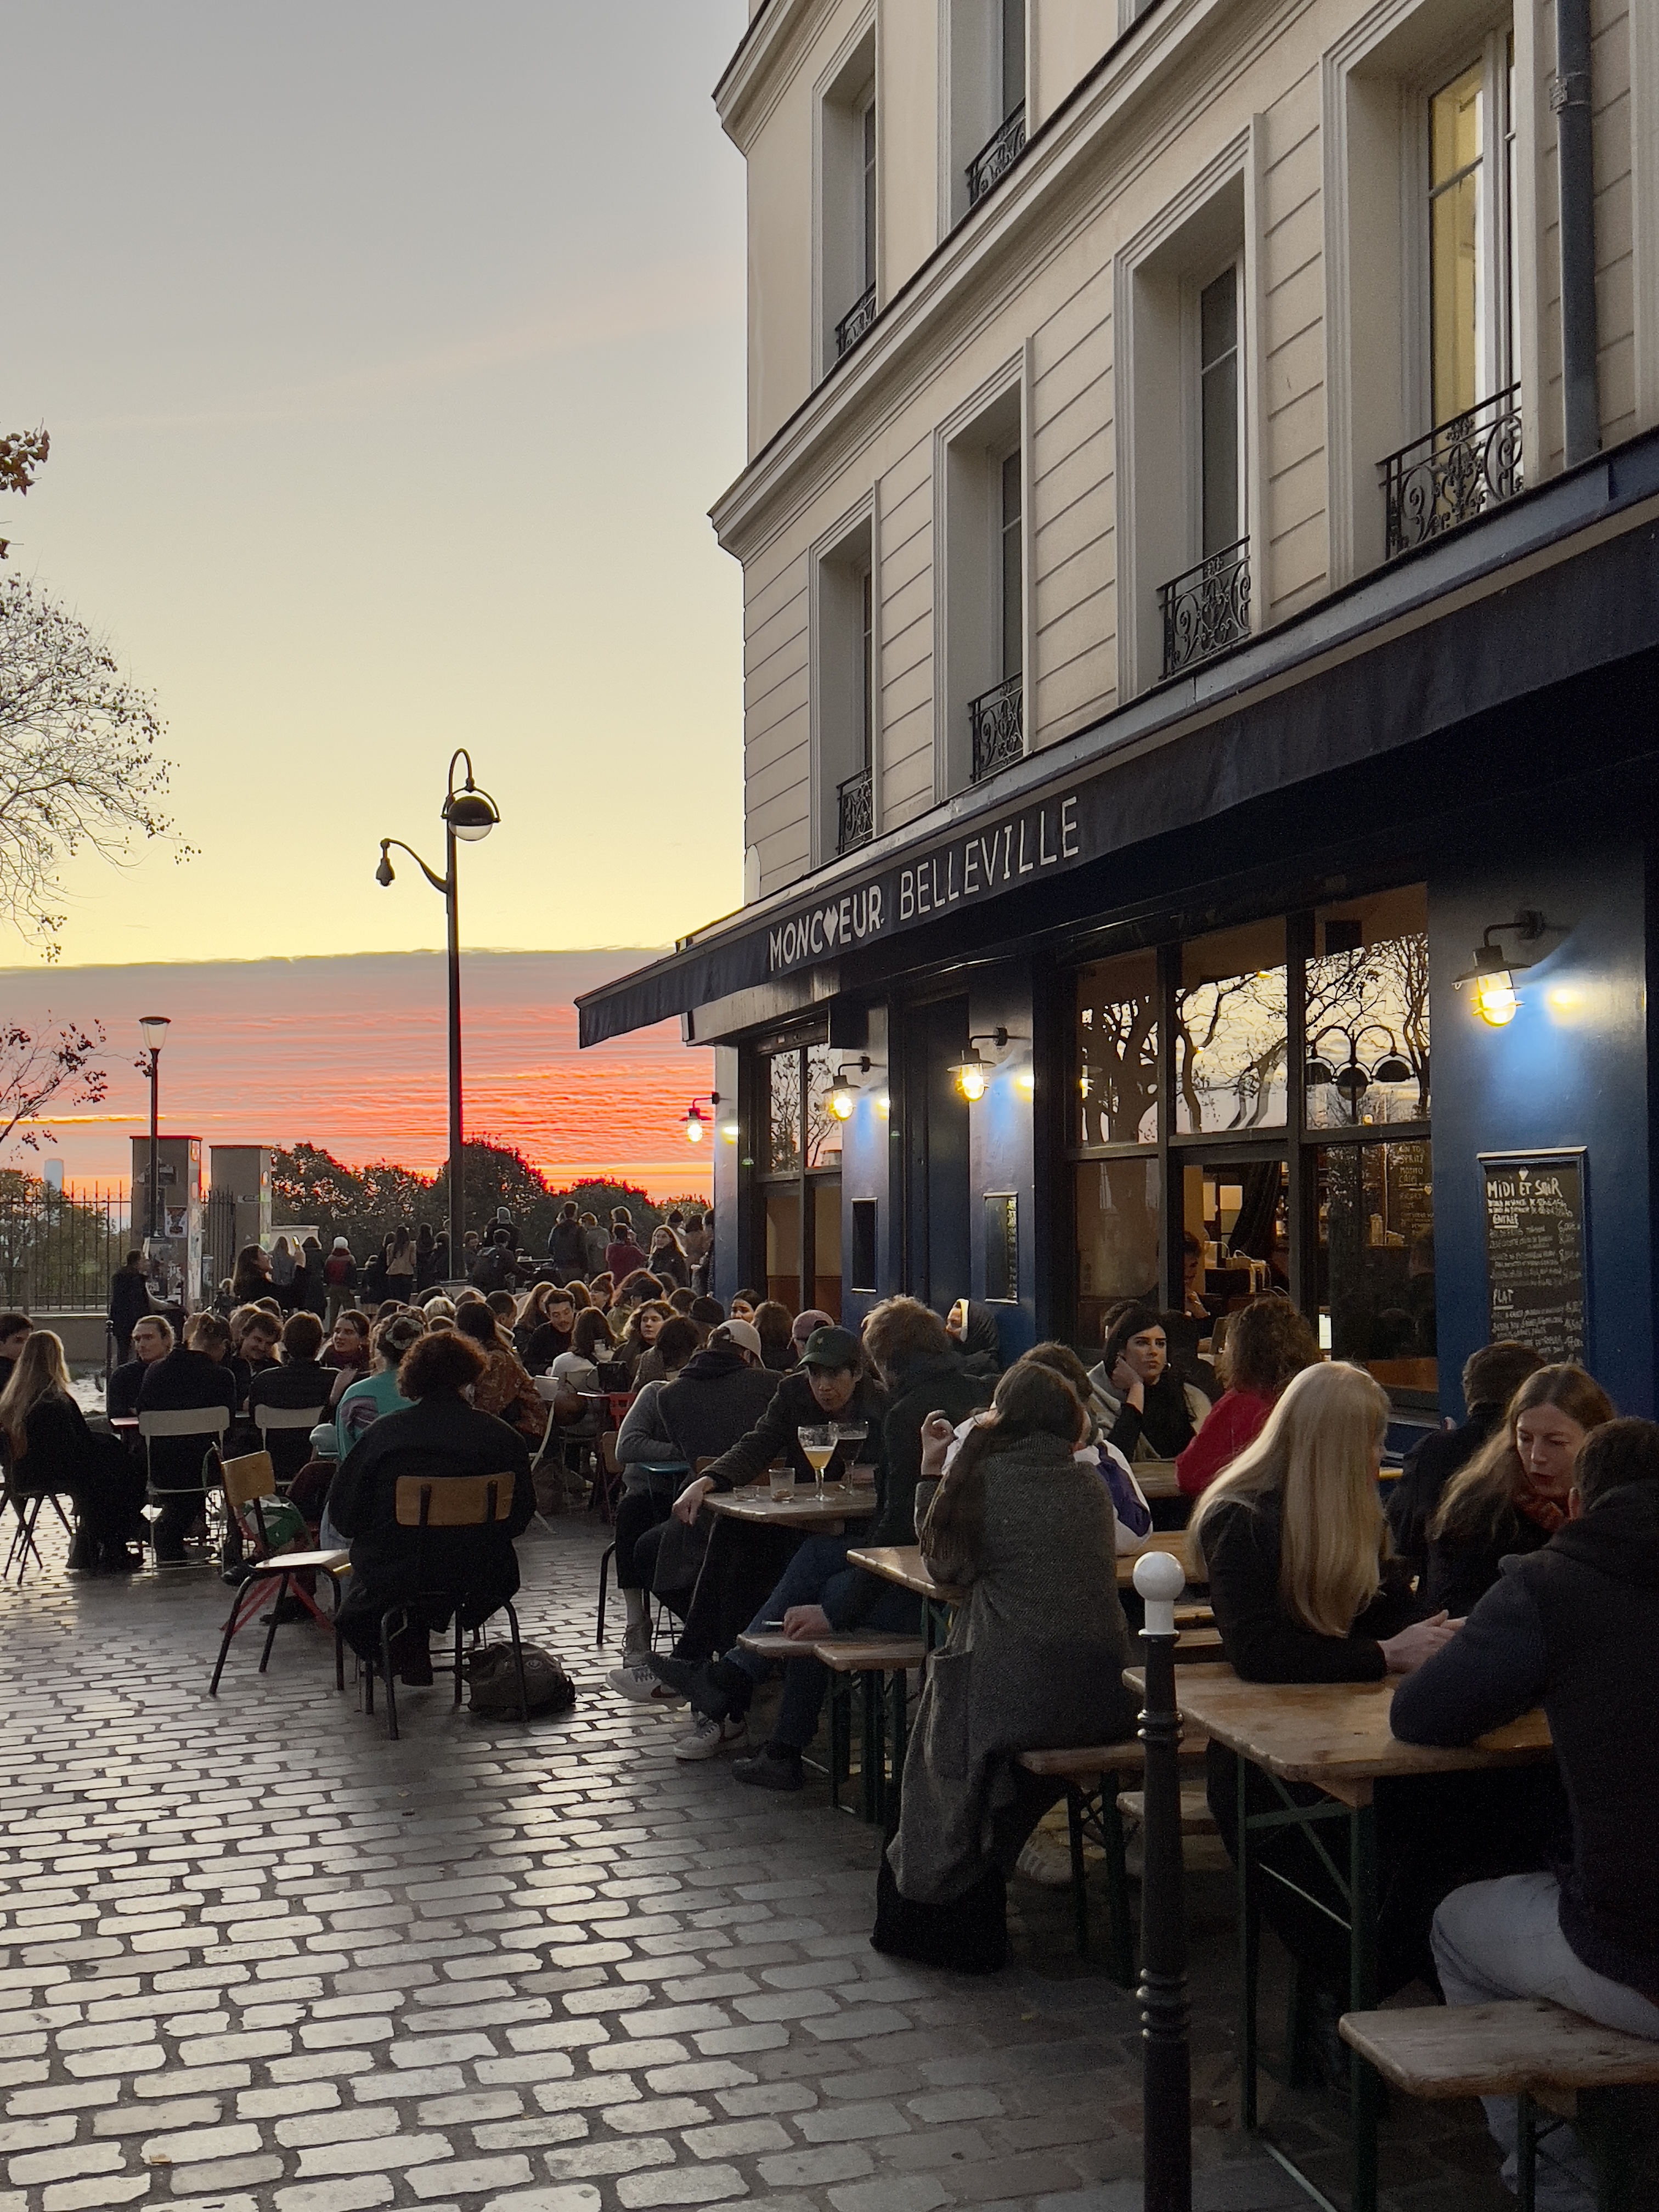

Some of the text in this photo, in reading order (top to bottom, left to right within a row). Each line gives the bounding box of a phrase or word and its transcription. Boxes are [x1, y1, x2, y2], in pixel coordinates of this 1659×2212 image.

[900, 796, 1080, 921] BELLEVILLE
[1519, 1182, 1533, 1196] ET
[1493, 1288, 1514, 1305] PLAT
